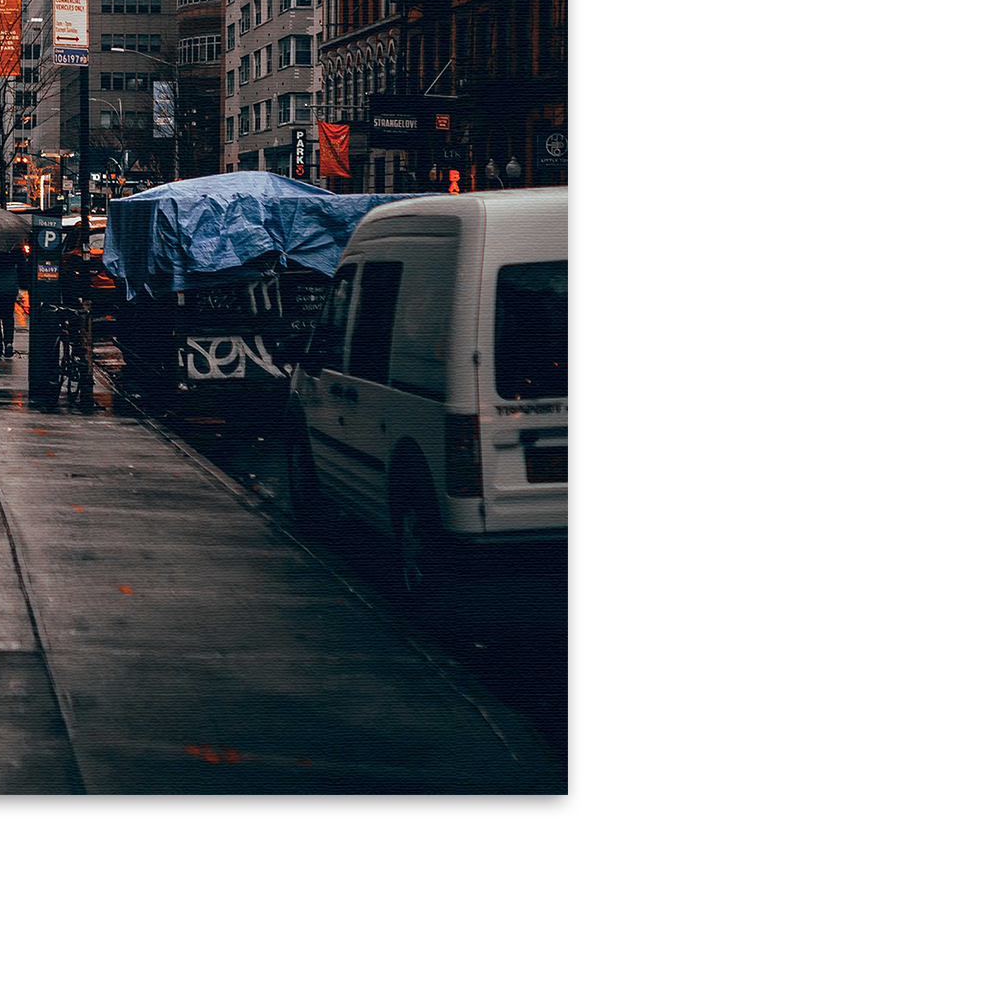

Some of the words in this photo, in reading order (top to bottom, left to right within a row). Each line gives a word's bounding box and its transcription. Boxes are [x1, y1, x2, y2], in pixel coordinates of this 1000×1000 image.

[55, 4, 74, 12] VEHICLES
[55, 54, 80, 63] 106197
[373, 118, 418, 128] STRANGELOVE
[296, 131, 305, 165] PARK
[44, 230, 56, 248] P
